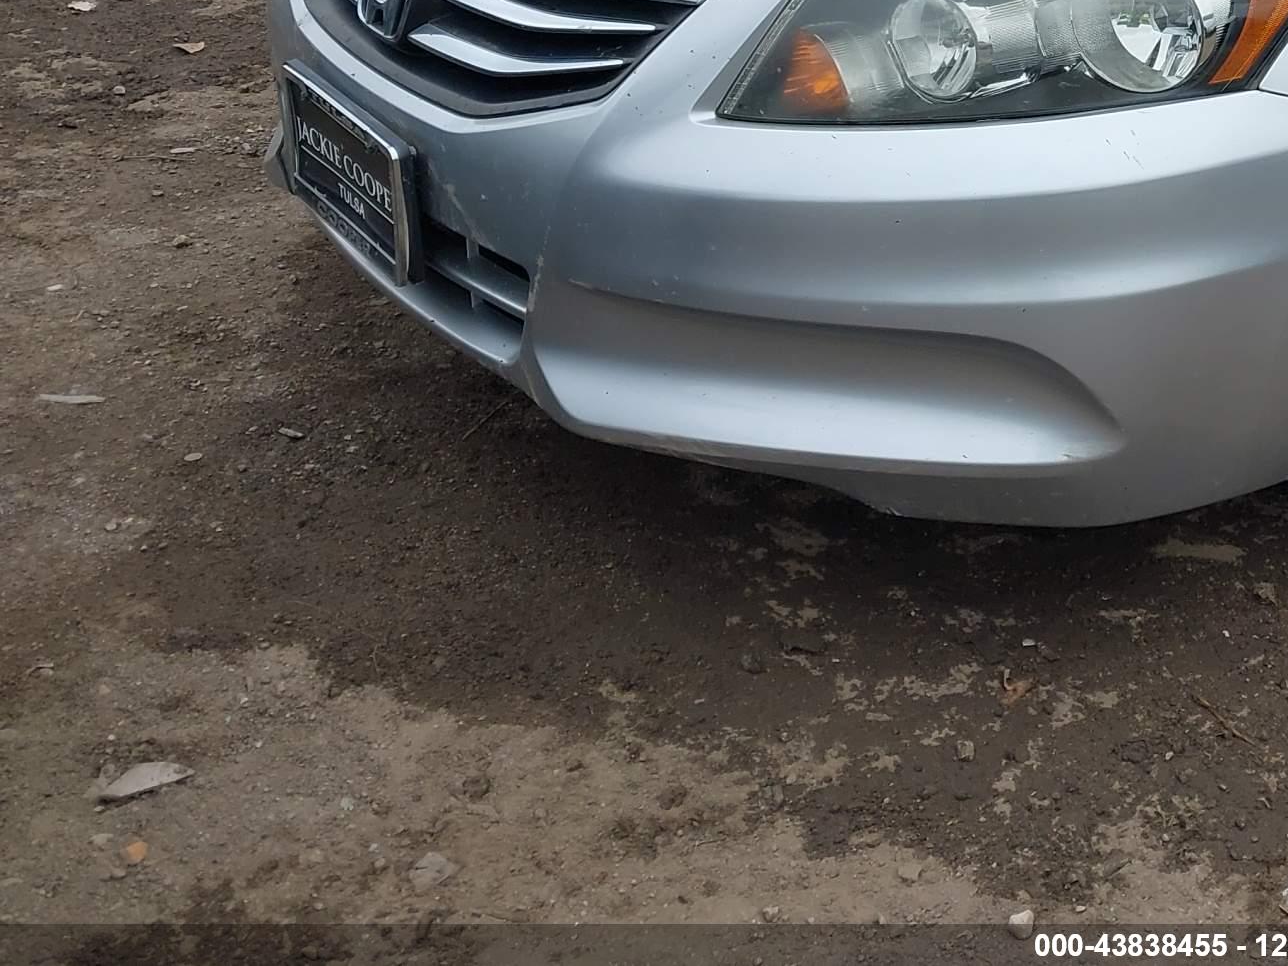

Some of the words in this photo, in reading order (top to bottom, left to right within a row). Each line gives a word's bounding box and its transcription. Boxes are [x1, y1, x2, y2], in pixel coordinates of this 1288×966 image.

[297, 117, 343, 169] JACKIE
[343, 155, 392, 212] COOPE
[338, 183, 366, 220] TULSA
